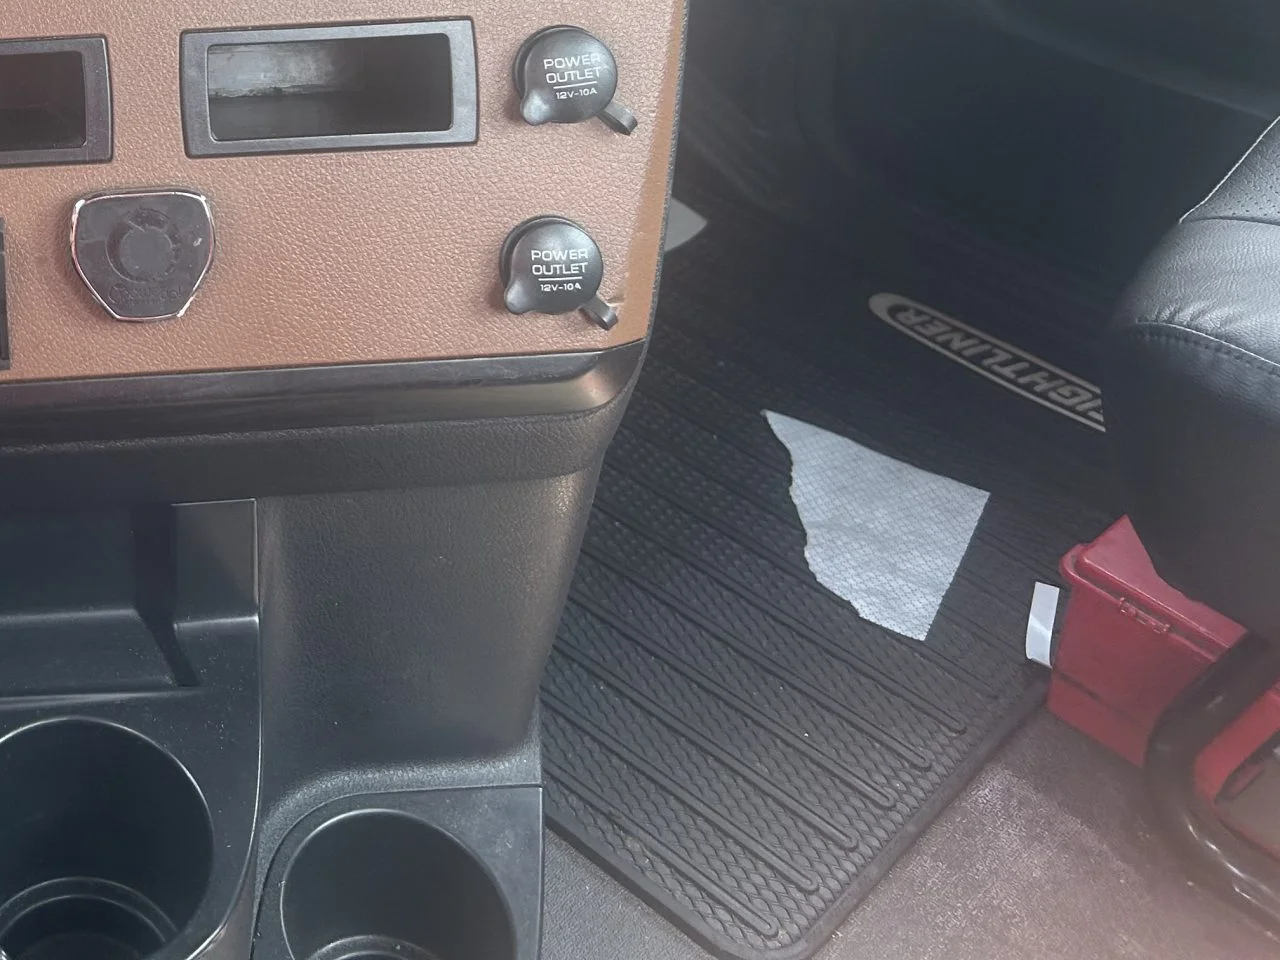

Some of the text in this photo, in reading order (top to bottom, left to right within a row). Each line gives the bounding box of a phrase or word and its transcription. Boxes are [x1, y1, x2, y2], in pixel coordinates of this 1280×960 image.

[543, 52, 601, 69] POWER
[546, 66, 602, 84] OUTLET
[556, 87, 598, 100] 12V-10A
[531, 248, 589, 261] POWER
[532, 262, 589, 276] OUTLET
[540, 282, 581, 292] 12V-10A
[896, 308, 1105, 422] IGHTLINER
